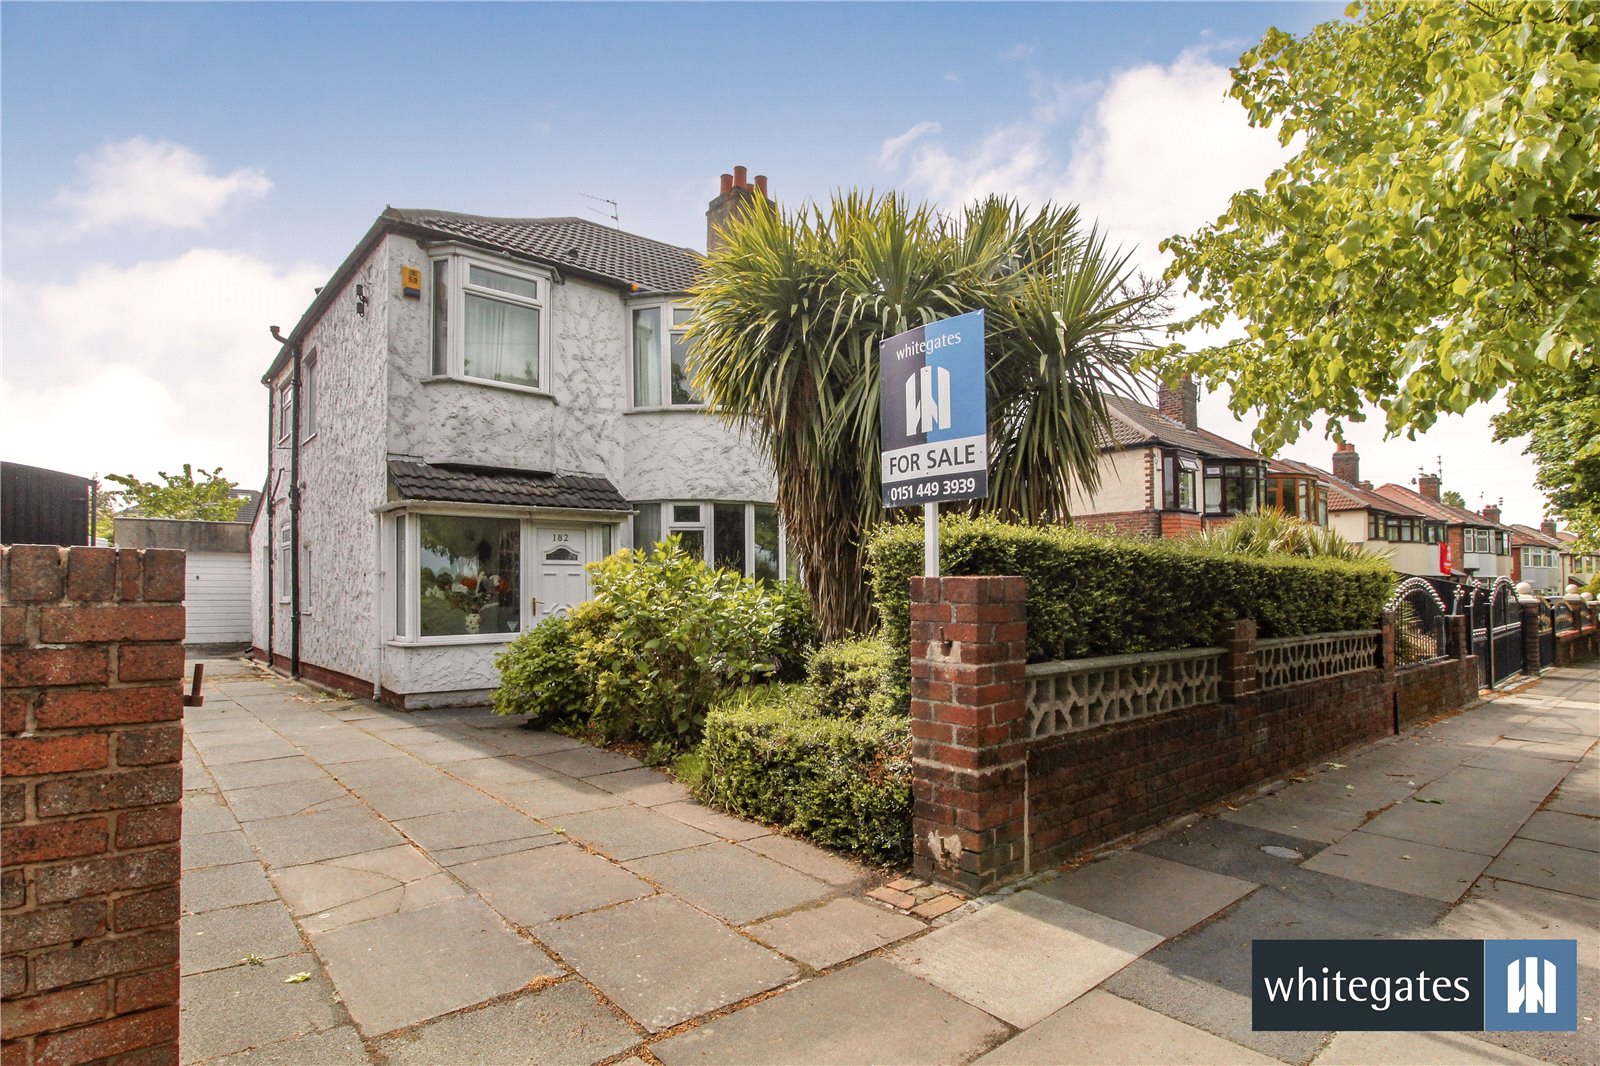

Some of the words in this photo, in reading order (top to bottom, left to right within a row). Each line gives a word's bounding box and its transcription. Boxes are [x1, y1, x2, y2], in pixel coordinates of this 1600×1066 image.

[896, 332, 962, 361] whitegates
[889, 453, 921, 475] FOR
[926, 444, 976, 470] SALE
[890, 485, 913, 501] 0151
[916, 481, 940, 498] 449
[942, 477, 975, 495] 3939
[553, 533, 569, 542] 182
